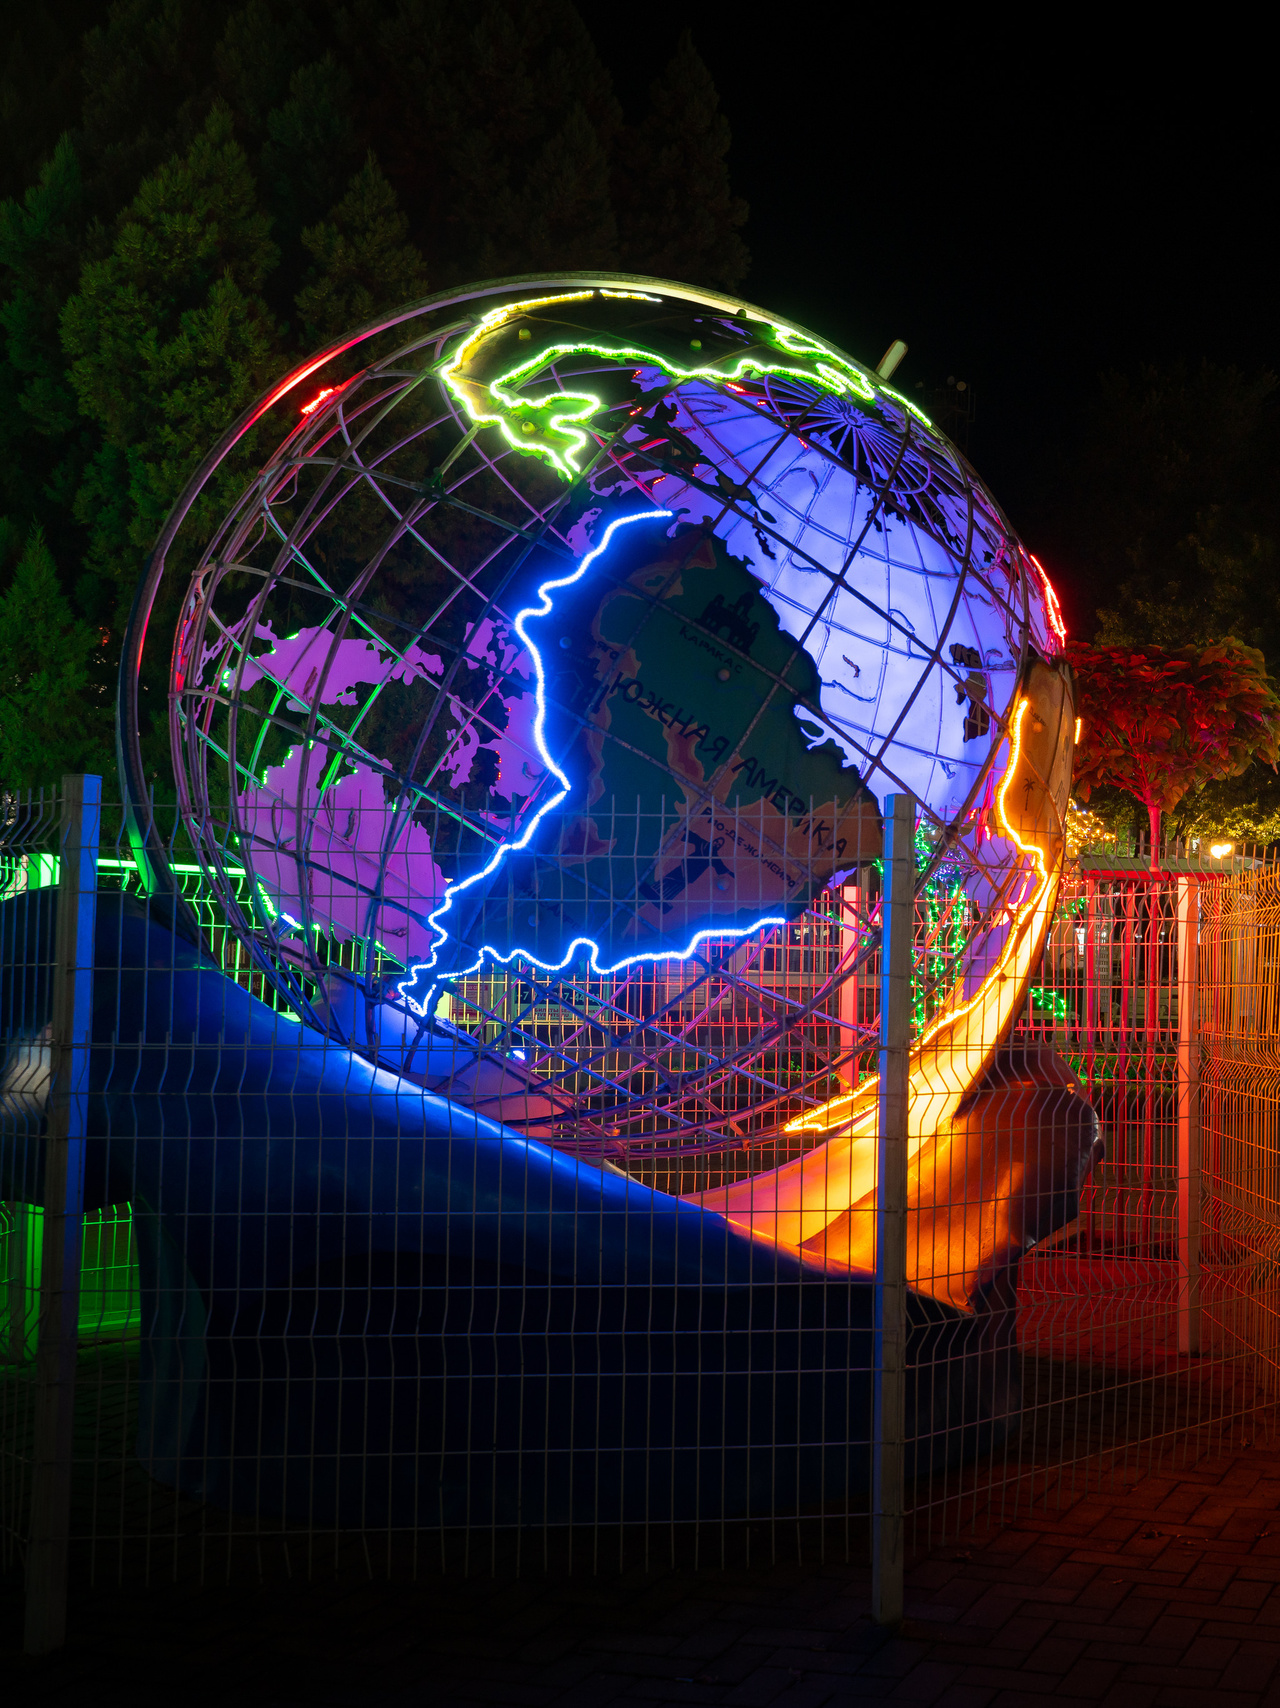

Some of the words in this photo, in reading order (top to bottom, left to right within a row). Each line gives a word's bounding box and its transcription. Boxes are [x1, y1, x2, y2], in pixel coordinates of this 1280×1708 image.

[497, 401, 546, 434] ПАНАА
[679, 625, 743, 674] КАРАКАС
[609, 671, 730, 762] ЮЖНАЯ
[731, 755, 848, 860] АМЕРИКА
